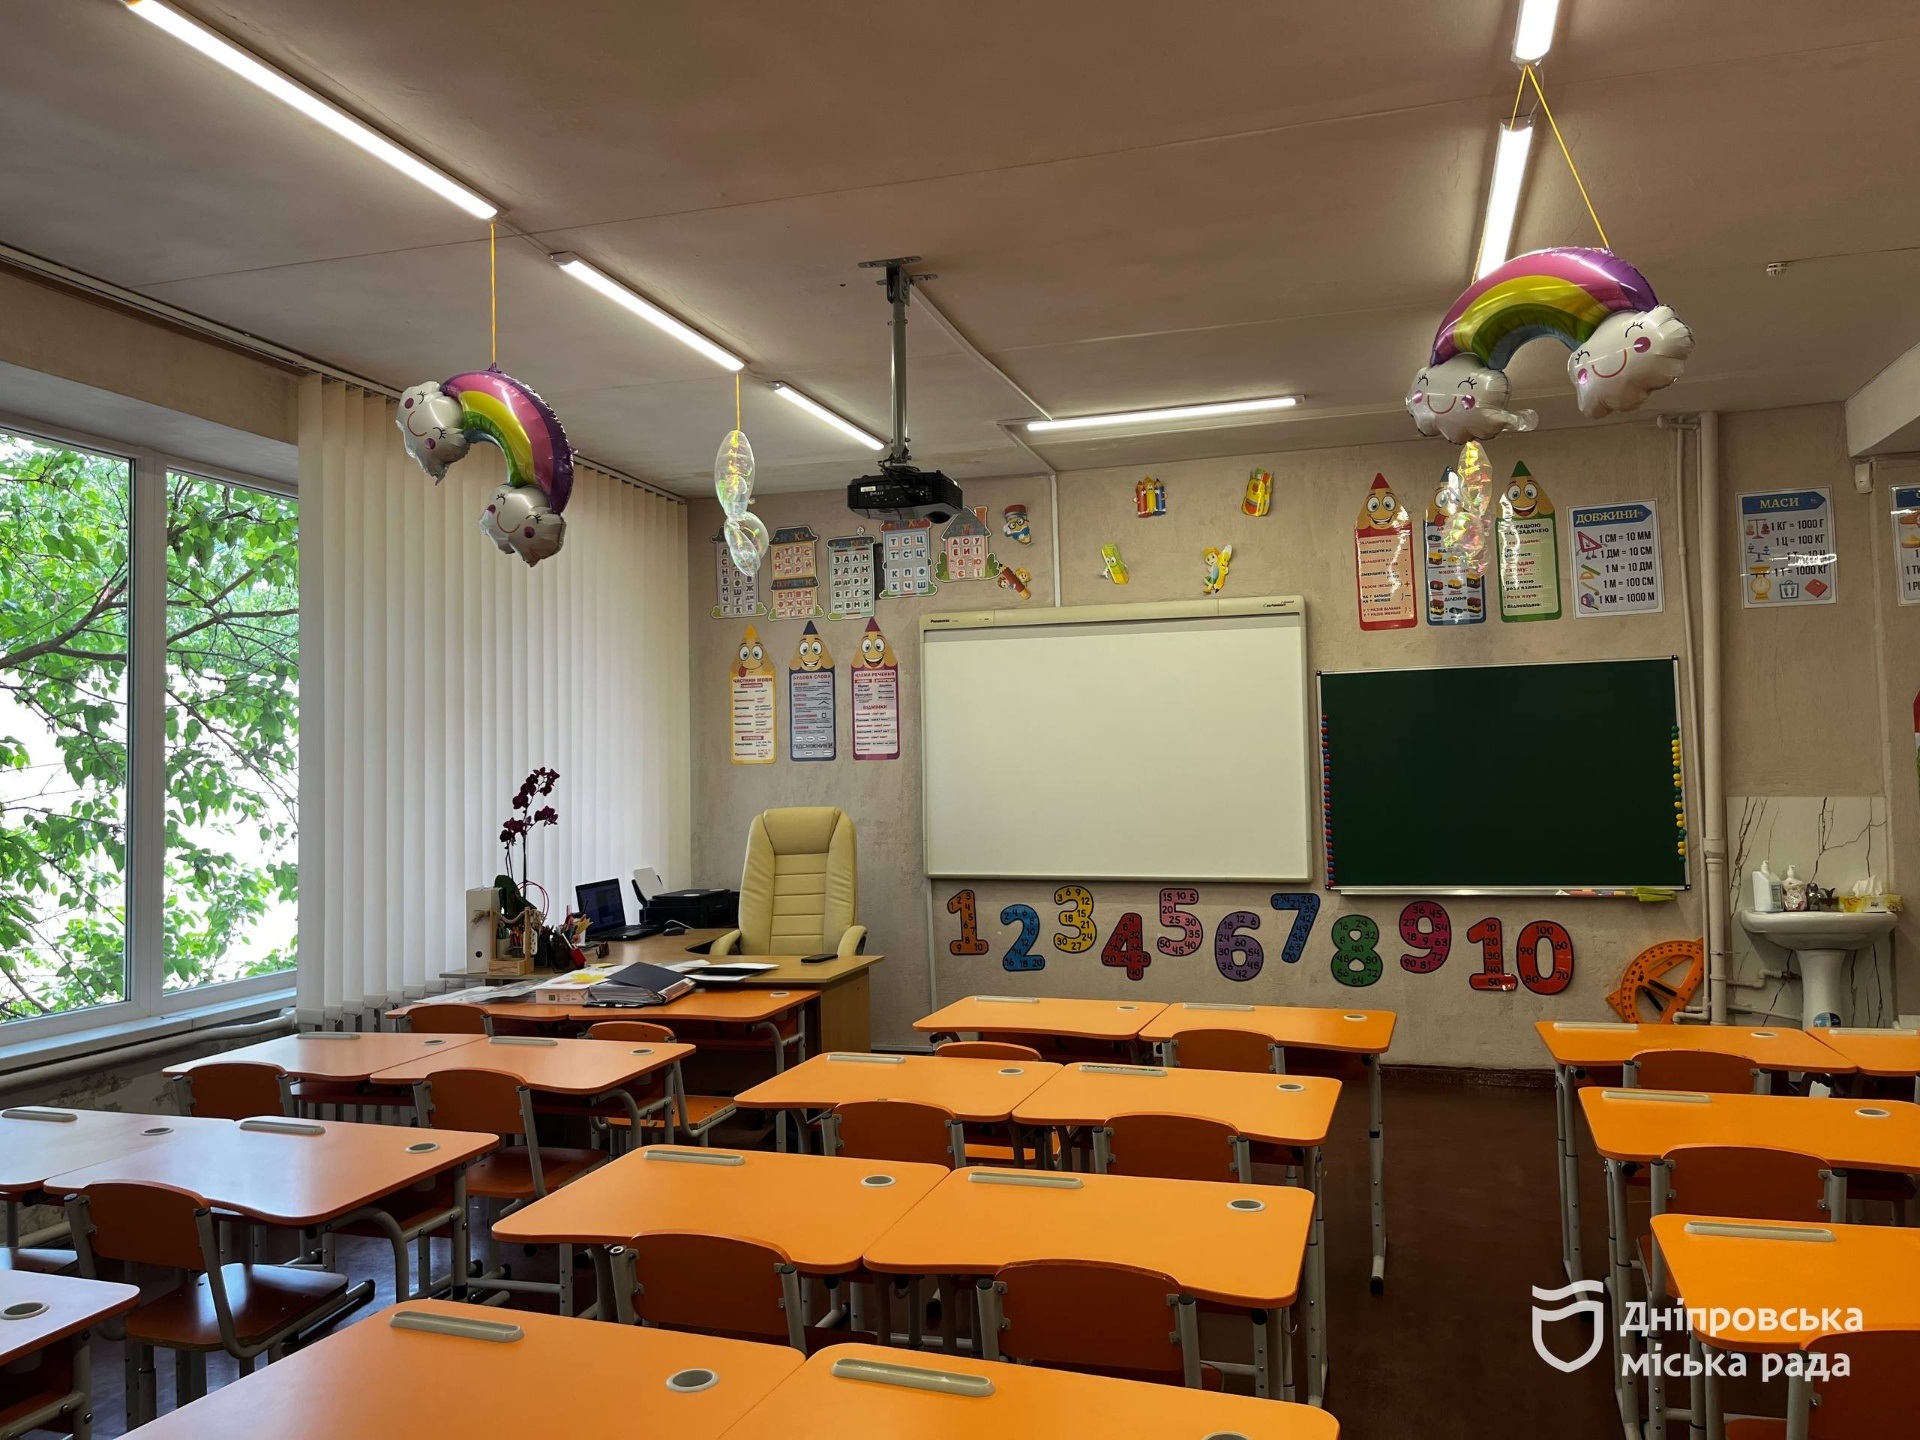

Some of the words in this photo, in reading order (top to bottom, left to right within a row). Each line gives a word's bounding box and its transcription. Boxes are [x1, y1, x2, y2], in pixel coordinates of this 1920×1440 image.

[1760, 498, 1799, 508] МАСИ
[1576, 510, 1637, 524] ДОВЖИНИ
[1777, 522, 1787, 530] КГ
[1798, 520, 1817, 529] 1000
[1605, 534, 1616, 542] СМ
[1626, 533, 1635, 541] 10
[1638, 531, 1651, 539] ММ
[1782, 537, 1788, 546] Ц
[1798, 536, 1812, 544] 100
[1815, 535, 1824, 543] КГ
[1607, 549, 1619, 558] ДМ
[1630, 548, 1638, 556] 10
[1641, 546, 1652, 555] СМ
[1612, 564, 1618, 572] М
[1628, 563, 1637, 571] 10
[1639, 561, 1652, 571] ДМ
[1796, 566, 1815, 575] 1000
[1818, 565, 1828, 573] КГ
[1610, 580, 1616, 588] М
[1626, 578, 1640, 587] 100
[1642, 577, 1653, 585] СМ
[1605, 595, 1616, 603] КМ
[1627, 593, 1645, 602] 1000
[1081, 897, 1090, 905] 12
[1078, 910, 1086, 918] 15
[1429, 910, 1442, 918] 45
[1169, 916, 1180, 924] 25
[1189, 930, 1200, 938] 35
[1487, 924, 1497, 932] 10
[1536, 926, 1553, 935] 100
[947, 889, 989, 955] 1
[1000, 904, 1046, 972] 2
[1054, 885, 1097, 954] 3
[1101, 912, 1151, 980] 4
[1158, 888, 1203, 957] 5
[1215, 911, 1264, 982] 6
[1271, 893, 1320, 963] 7
[1331, 914, 1383, 987] 8
[1399, 901, 1451, 974] 9
[1467, 917, 1574, 995] 10
[1218, 934, 1230, 942] 24
[1235, 938, 1246, 947] 60
[1407, 932, 1416, 940] 18
[1071, 942, 1082, 950] 27
[1173, 946, 1184, 955] 45
[1185, 941, 1196, 950] 40
[1248, 948, 1259, 957] 54
[1432, 953, 1443, 961] 72
[1222, 962, 1233, 970] 36
[1236, 970, 1247, 978] 42
[1487, 965, 1500, 973] 40
[1557, 972, 1568, 980] 70
